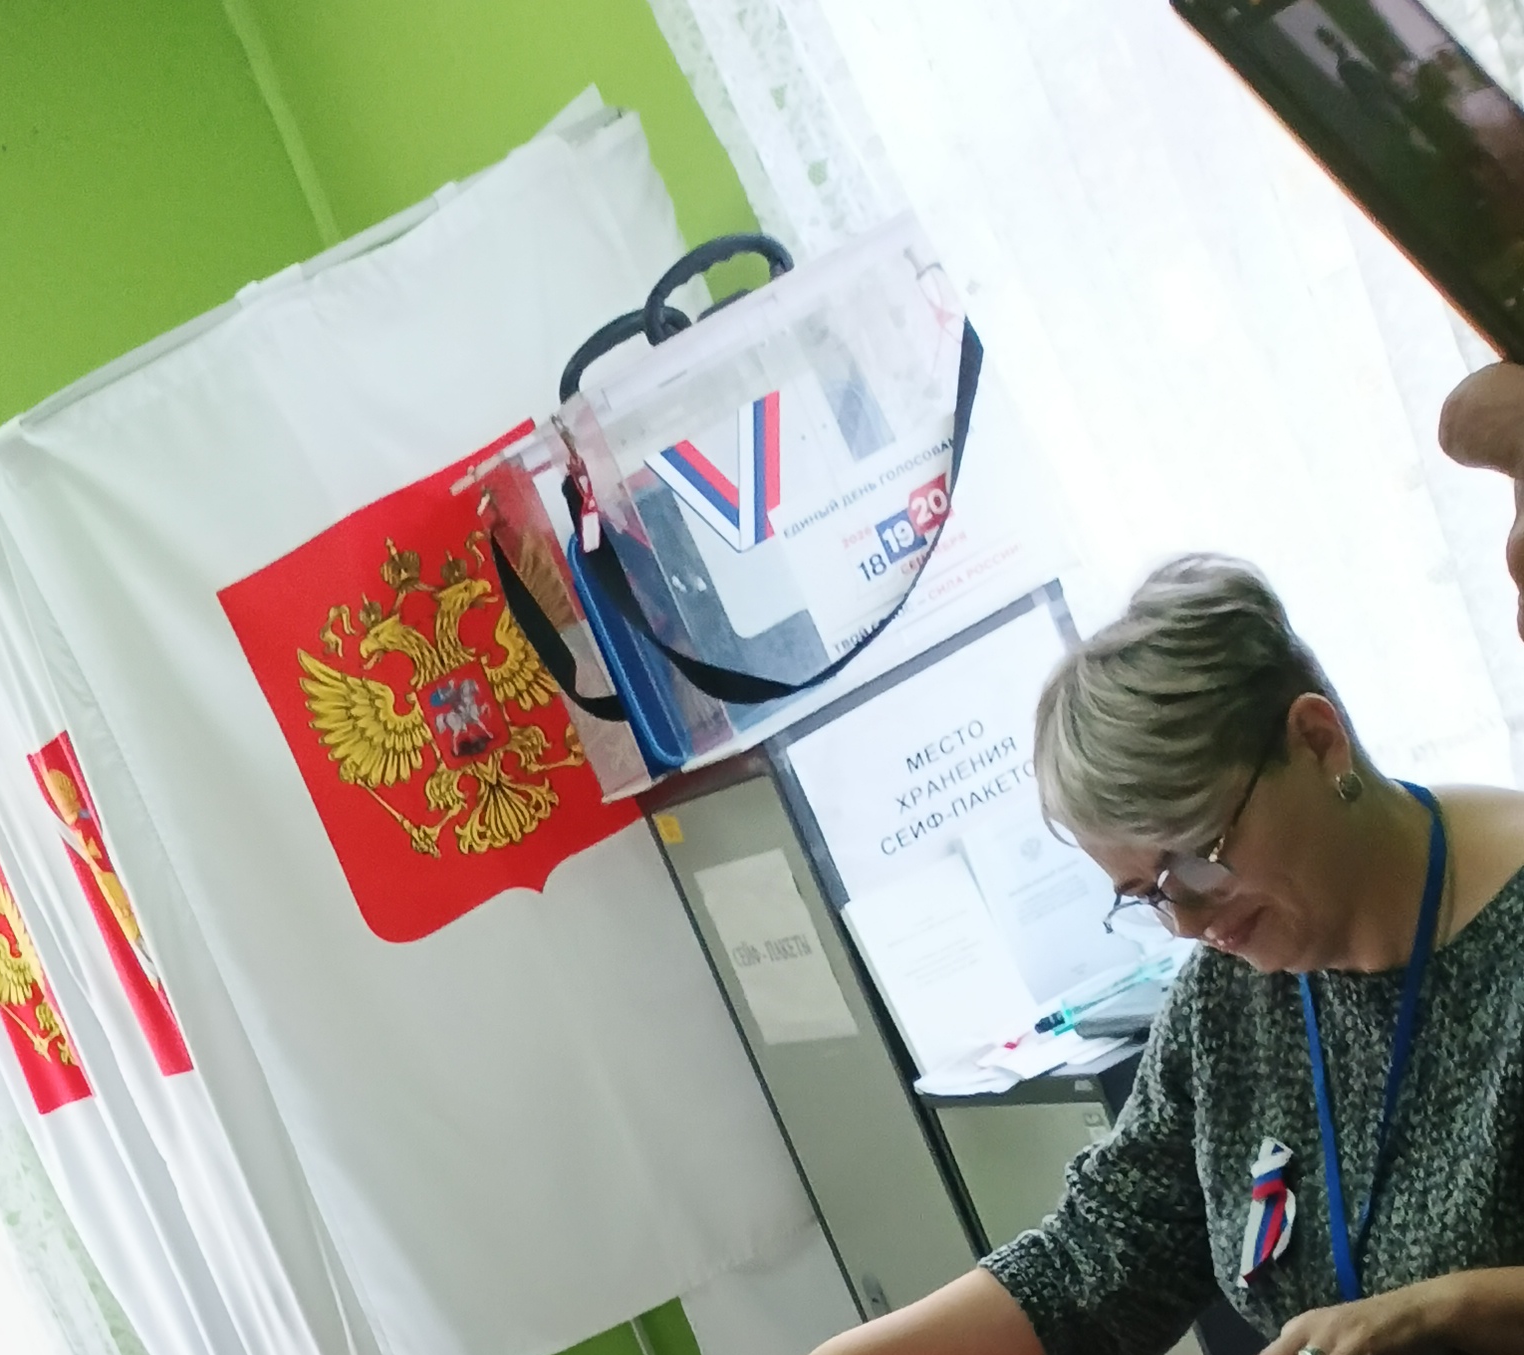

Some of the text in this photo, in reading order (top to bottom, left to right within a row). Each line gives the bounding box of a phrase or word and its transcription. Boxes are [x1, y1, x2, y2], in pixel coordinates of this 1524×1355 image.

[783, 499, 840, 539] ЕДИНЫЙ
[842, 481, 877, 508] ДЕНЬ
[911, 488, 948, 526] 20
[881, 519, 915, 553] 19
[858, 553, 887, 581] 18
[906, 719, 984, 774] МЕСТО
[896, 736, 1017, 814] ХРАНЕНИЯ
[880, 758, 1037, 856] СЕЙФ-ПАКЕТО
